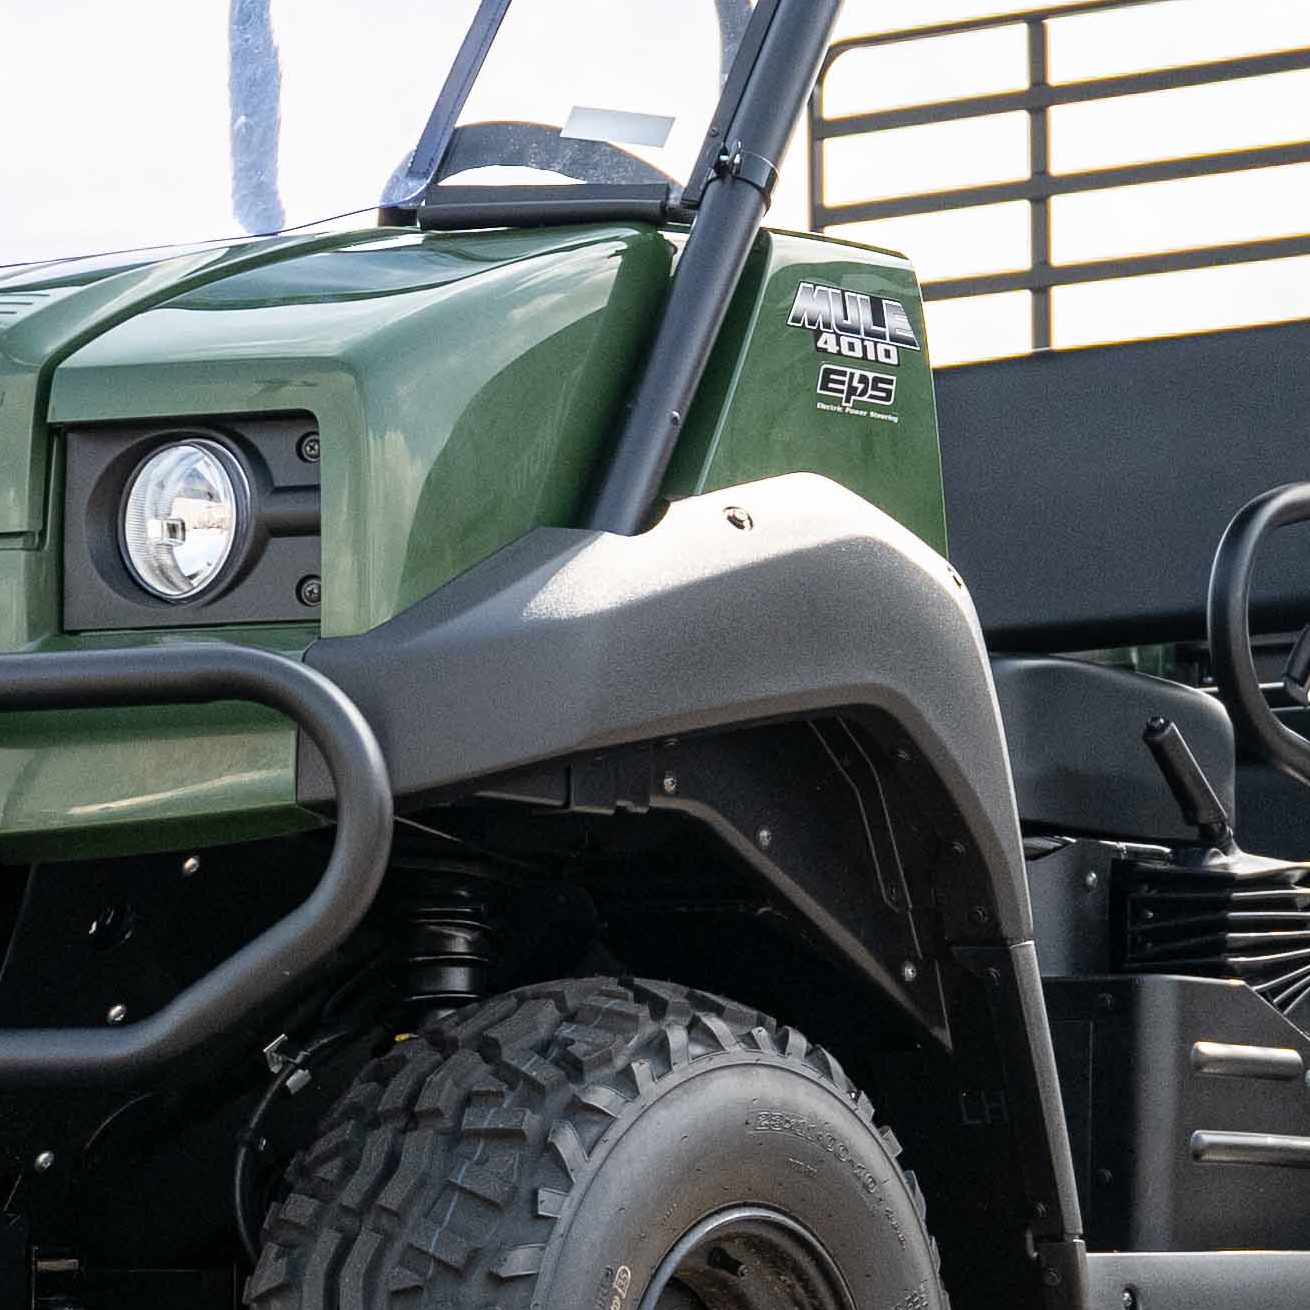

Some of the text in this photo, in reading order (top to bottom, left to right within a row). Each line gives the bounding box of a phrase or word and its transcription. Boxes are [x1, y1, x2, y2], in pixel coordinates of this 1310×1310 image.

[787, 281, 921, 351] MULE
[816, 333, 900, 366] 4010
[817, 364, 897, 407] EPS
